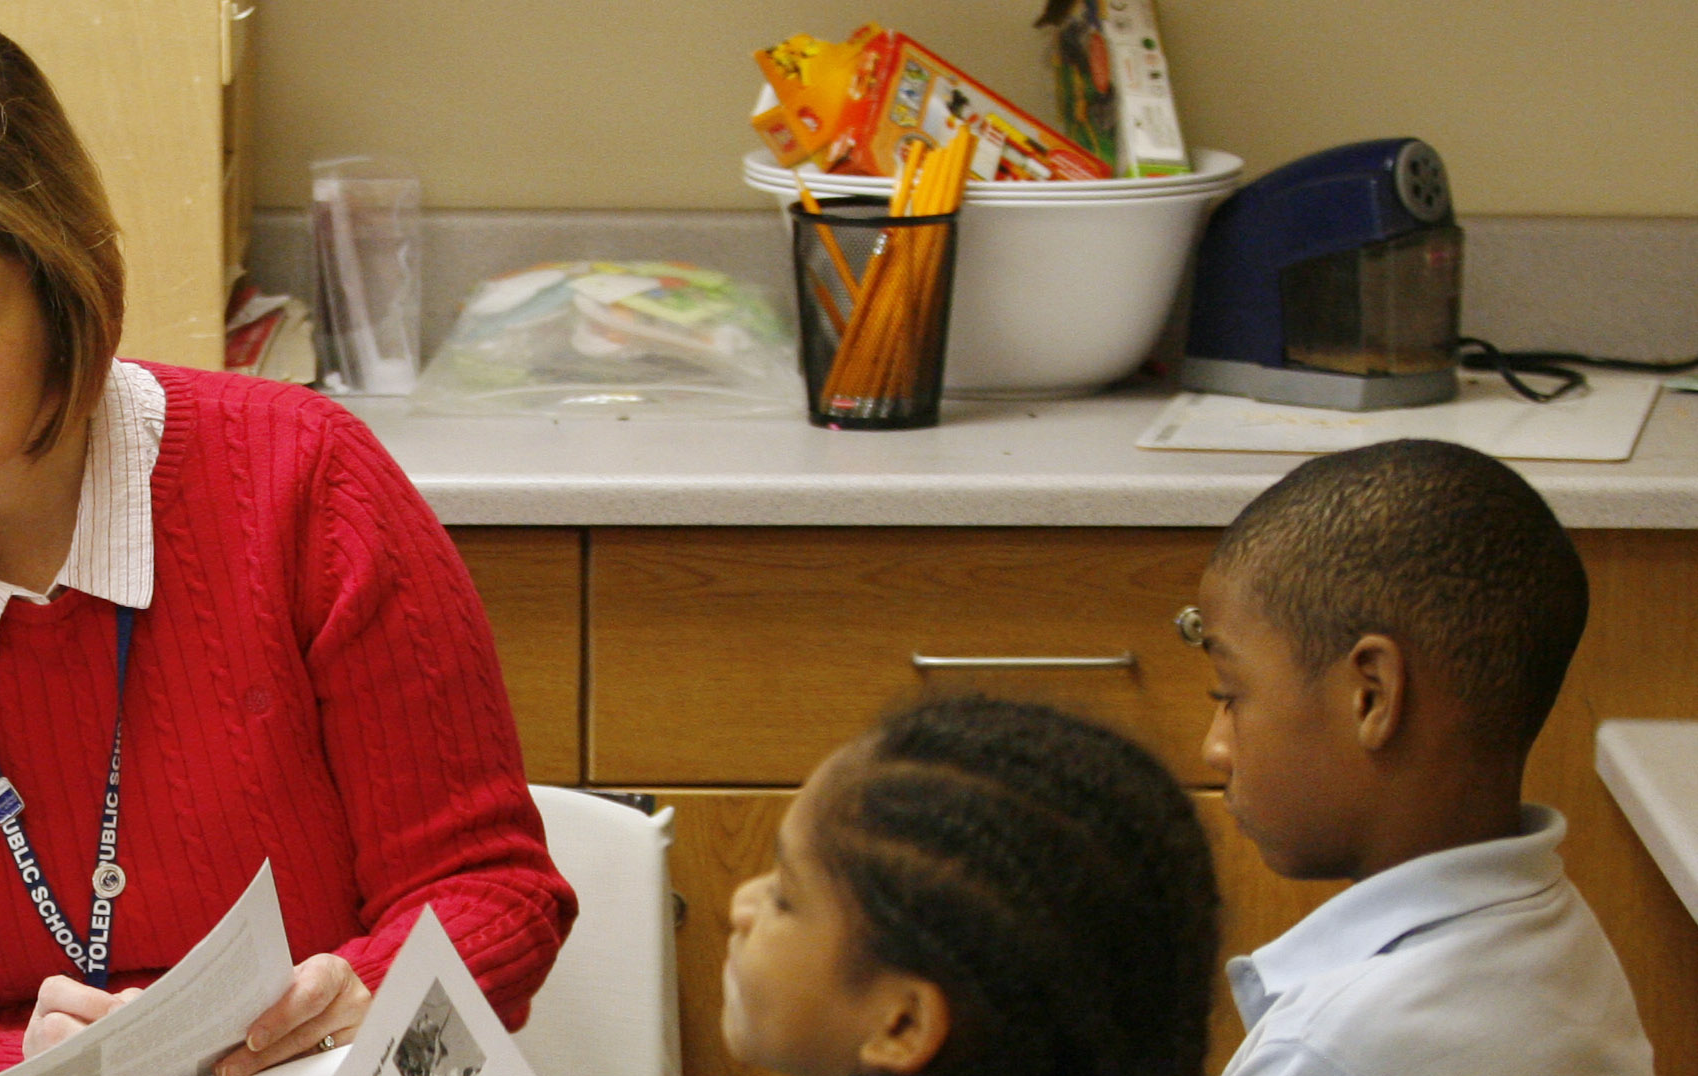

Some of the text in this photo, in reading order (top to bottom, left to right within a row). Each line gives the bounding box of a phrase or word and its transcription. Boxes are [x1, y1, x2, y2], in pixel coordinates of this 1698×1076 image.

[98, 791, 119, 866] UBLIC
[2, 817, 41, 884] UBLIC
[31, 885, 87, 974] SCHOOL
[88, 893, 112, 973] TOLED
